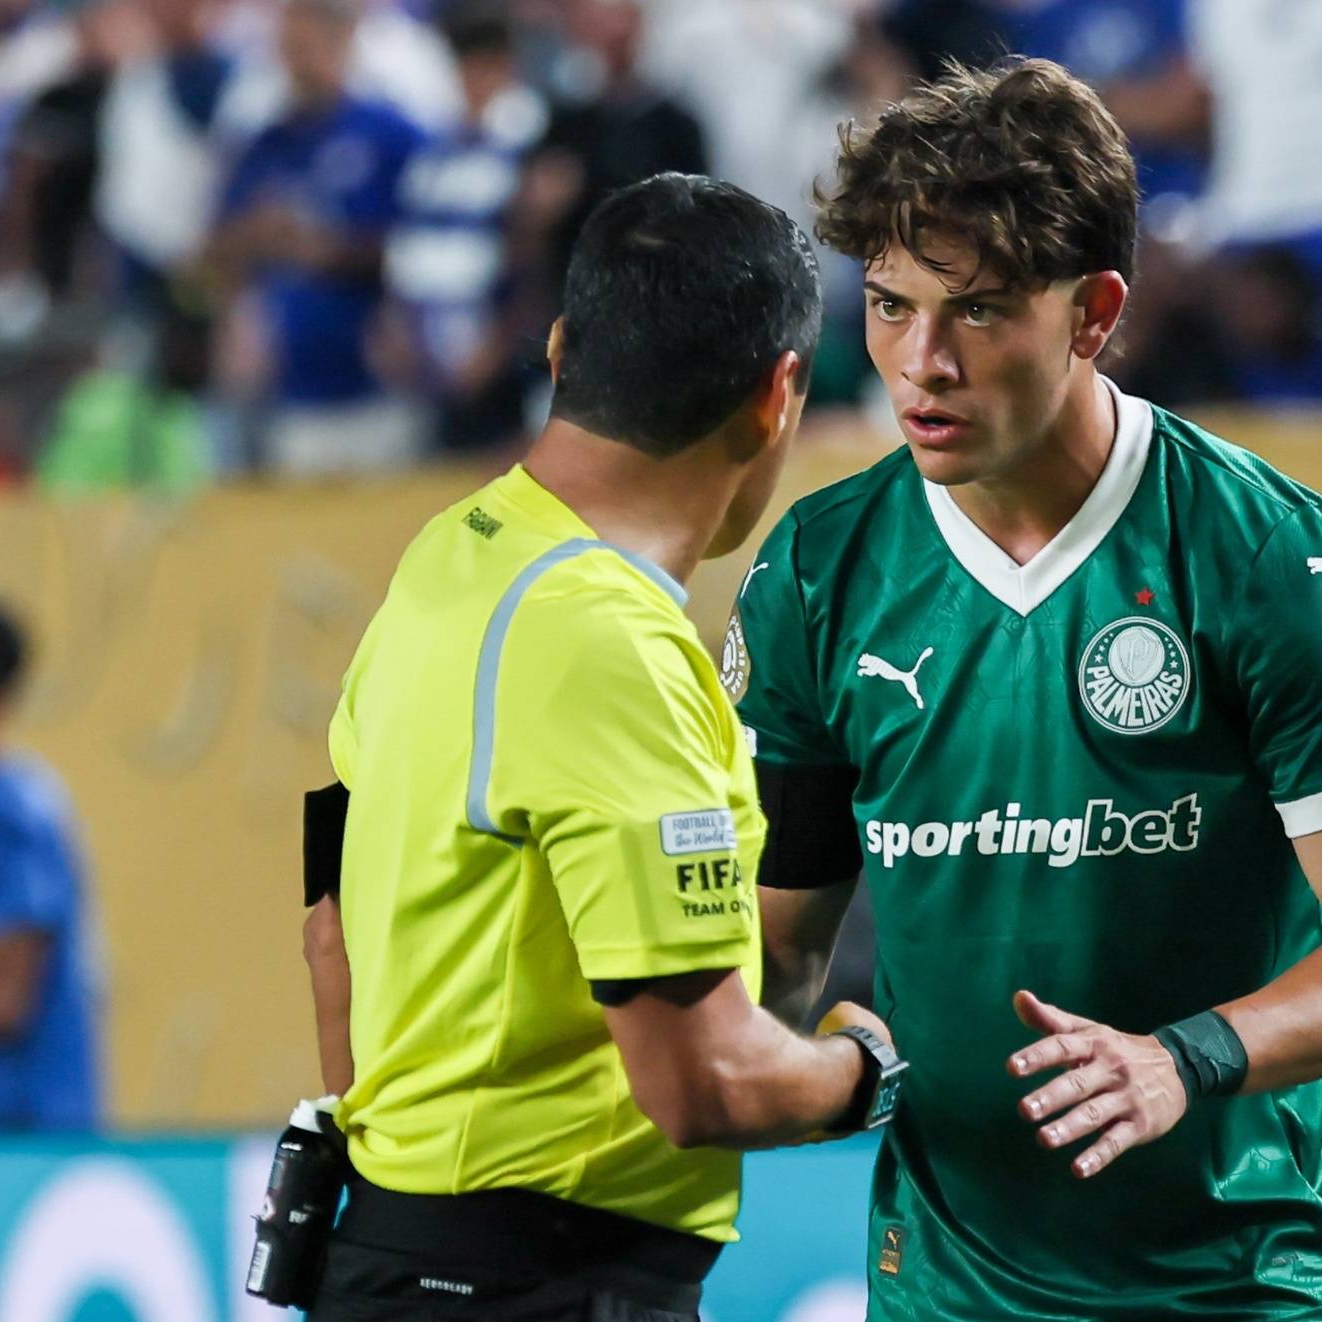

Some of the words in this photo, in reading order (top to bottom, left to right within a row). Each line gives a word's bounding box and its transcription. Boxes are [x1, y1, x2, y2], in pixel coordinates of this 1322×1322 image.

[1086, 665, 1184, 727] PALMEIRAS
[673, 815, 716, 831] FOOTBALL
[866, 792, 1202, 868] sportingbet
[676, 859, 742, 892] FIFA
[682, 902, 725, 918] TEAM
